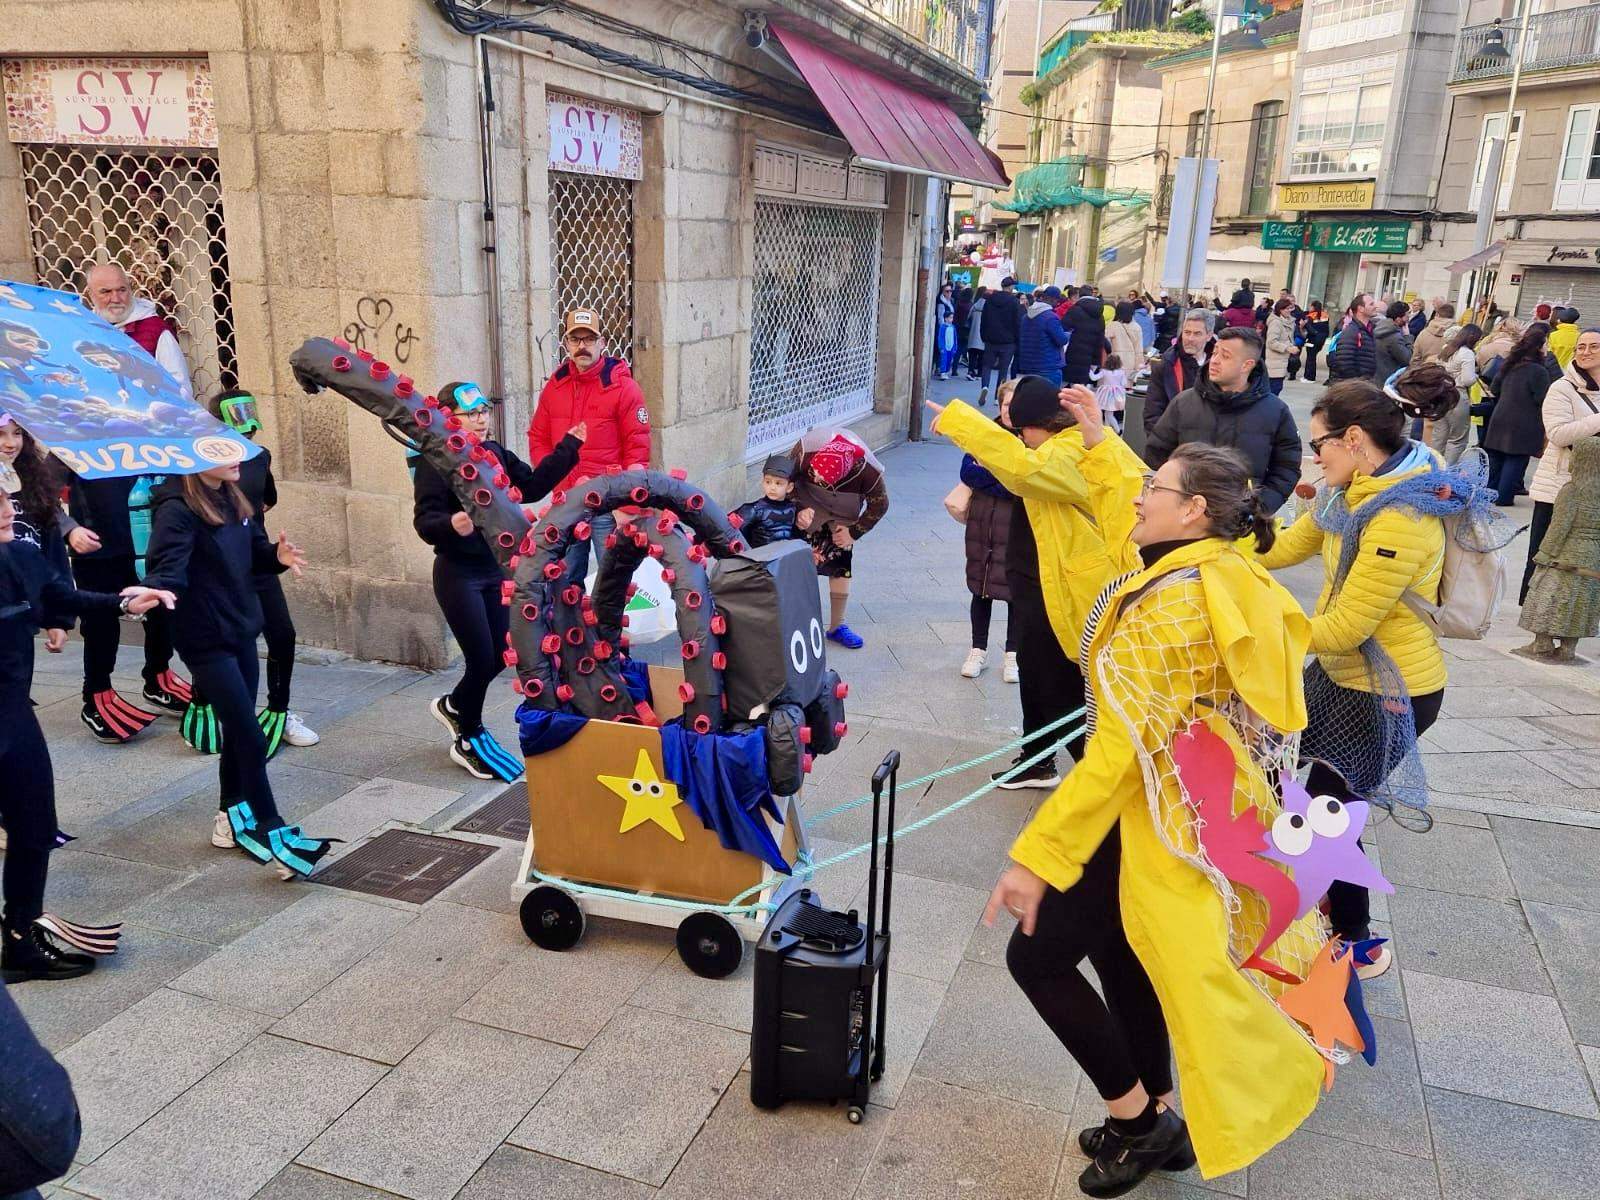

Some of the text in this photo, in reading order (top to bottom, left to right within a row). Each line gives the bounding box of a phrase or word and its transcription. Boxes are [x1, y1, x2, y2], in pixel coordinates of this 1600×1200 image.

[64, 96, 178, 105] SUSPIRO VINTAGE
[77, 71, 163, 136] SV
[564, 106, 611, 166] SV
[1285, 187, 1309, 203] Diario
[1318, 186, 1366, 203] Pontevedra
[1269, 224, 1304, 237] EL ARTE
[1334, 226, 1379, 247] EL ARTE
[49, 442, 196, 473] BUZOS
